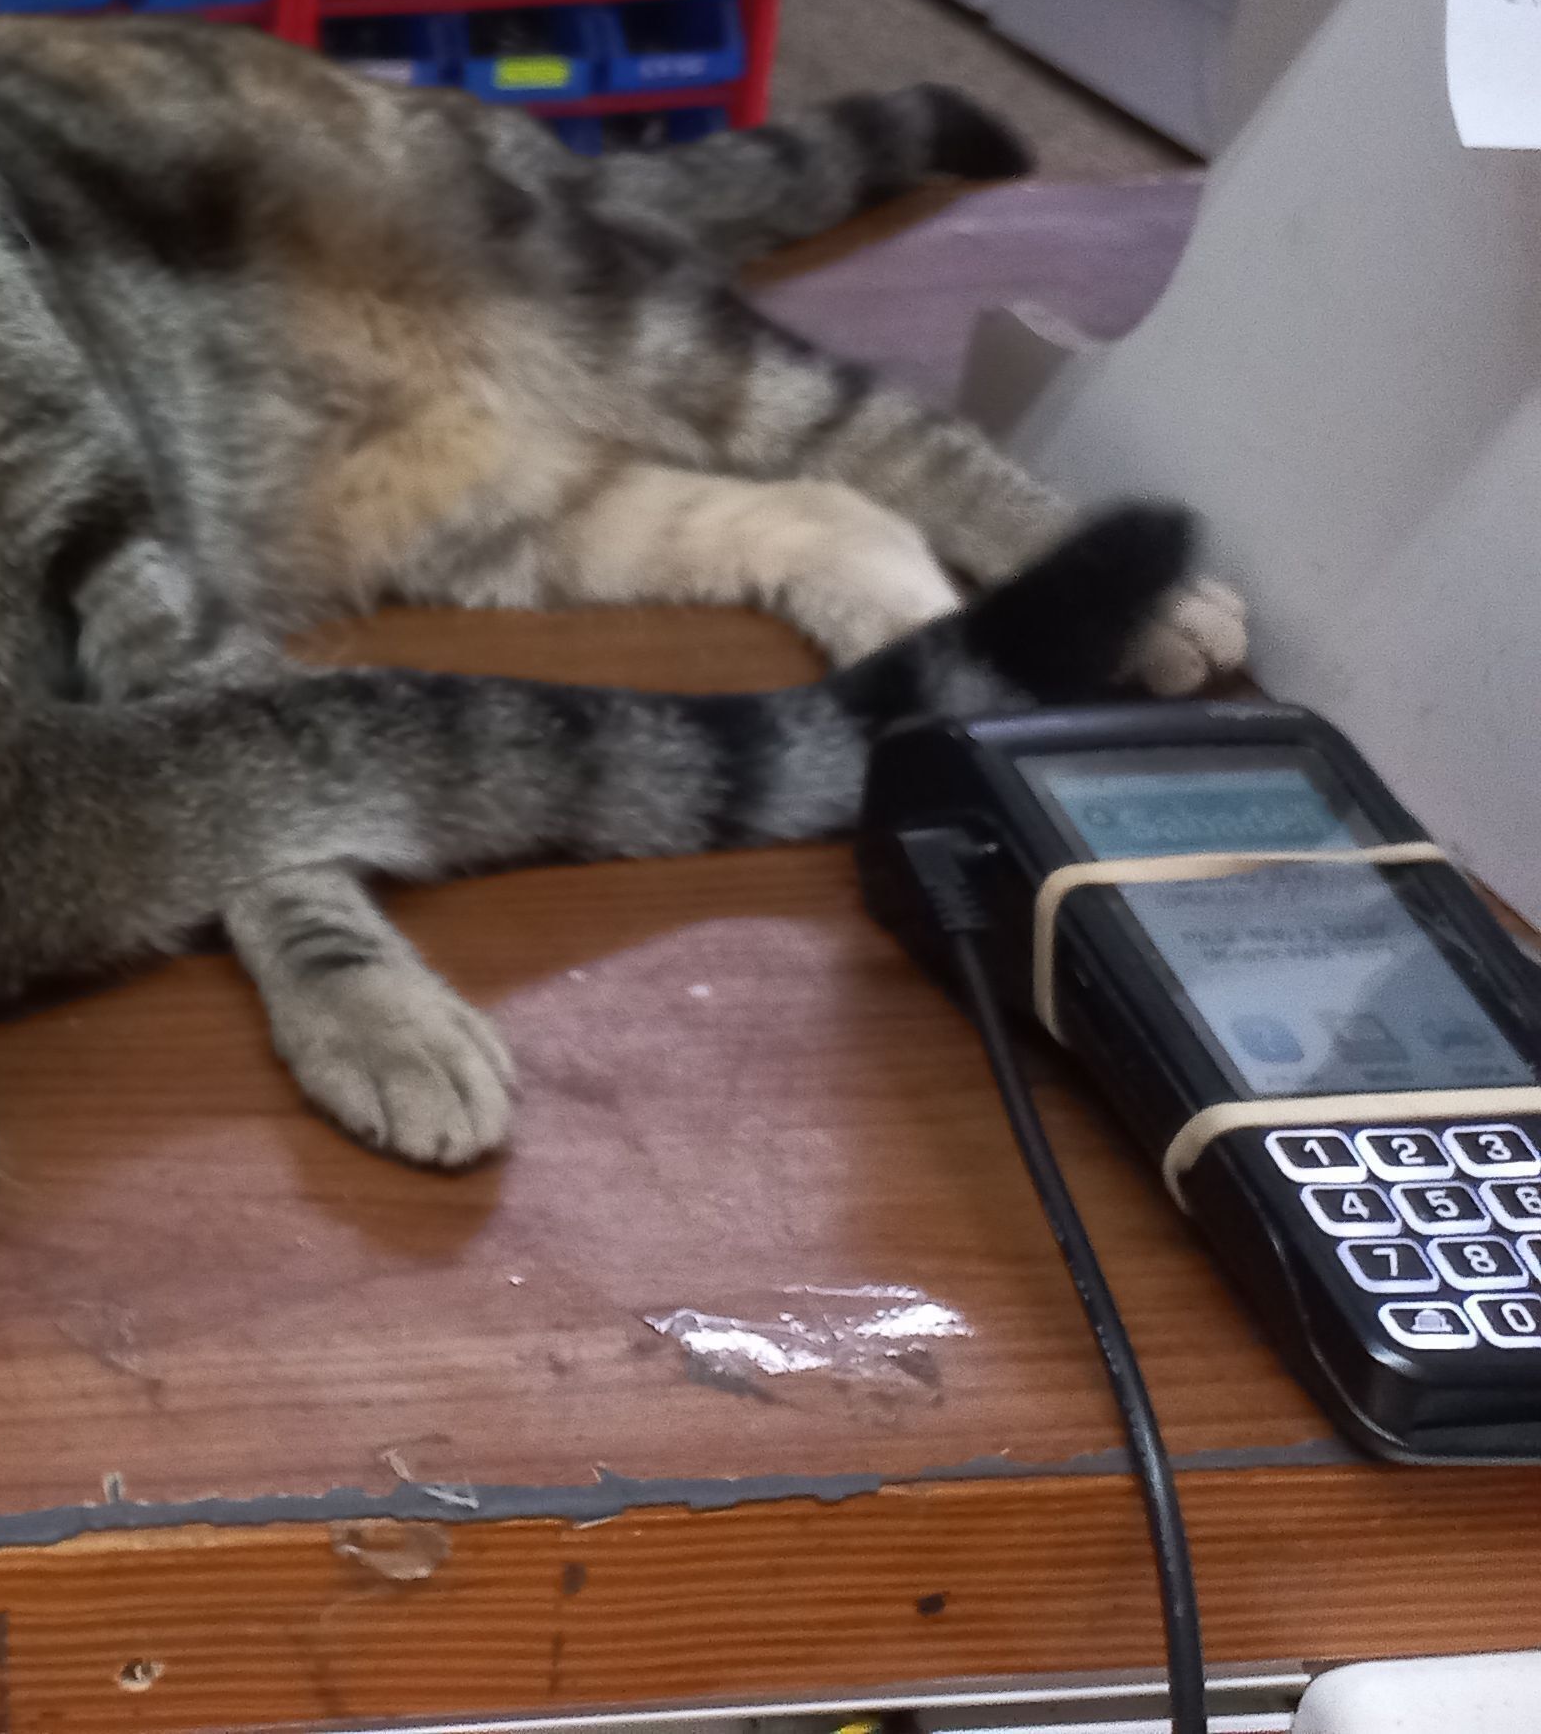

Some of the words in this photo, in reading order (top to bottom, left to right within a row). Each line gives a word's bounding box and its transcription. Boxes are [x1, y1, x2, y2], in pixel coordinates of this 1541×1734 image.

[1303, 1138, 1332, 1167] 1
[1390, 1136, 1427, 1166] 2
[1477, 1133, 1514, 1162] 3
[1341, 1190, 1371, 1221] 4
[1424, 1188, 1461, 1219] 5
[1514, 1185, 1541, 1215] 6
[1371, 1246, 1400, 1277] 7
[1462, 1243, 1499, 1274] 8
[1499, 1301, 1537, 1334] 0
